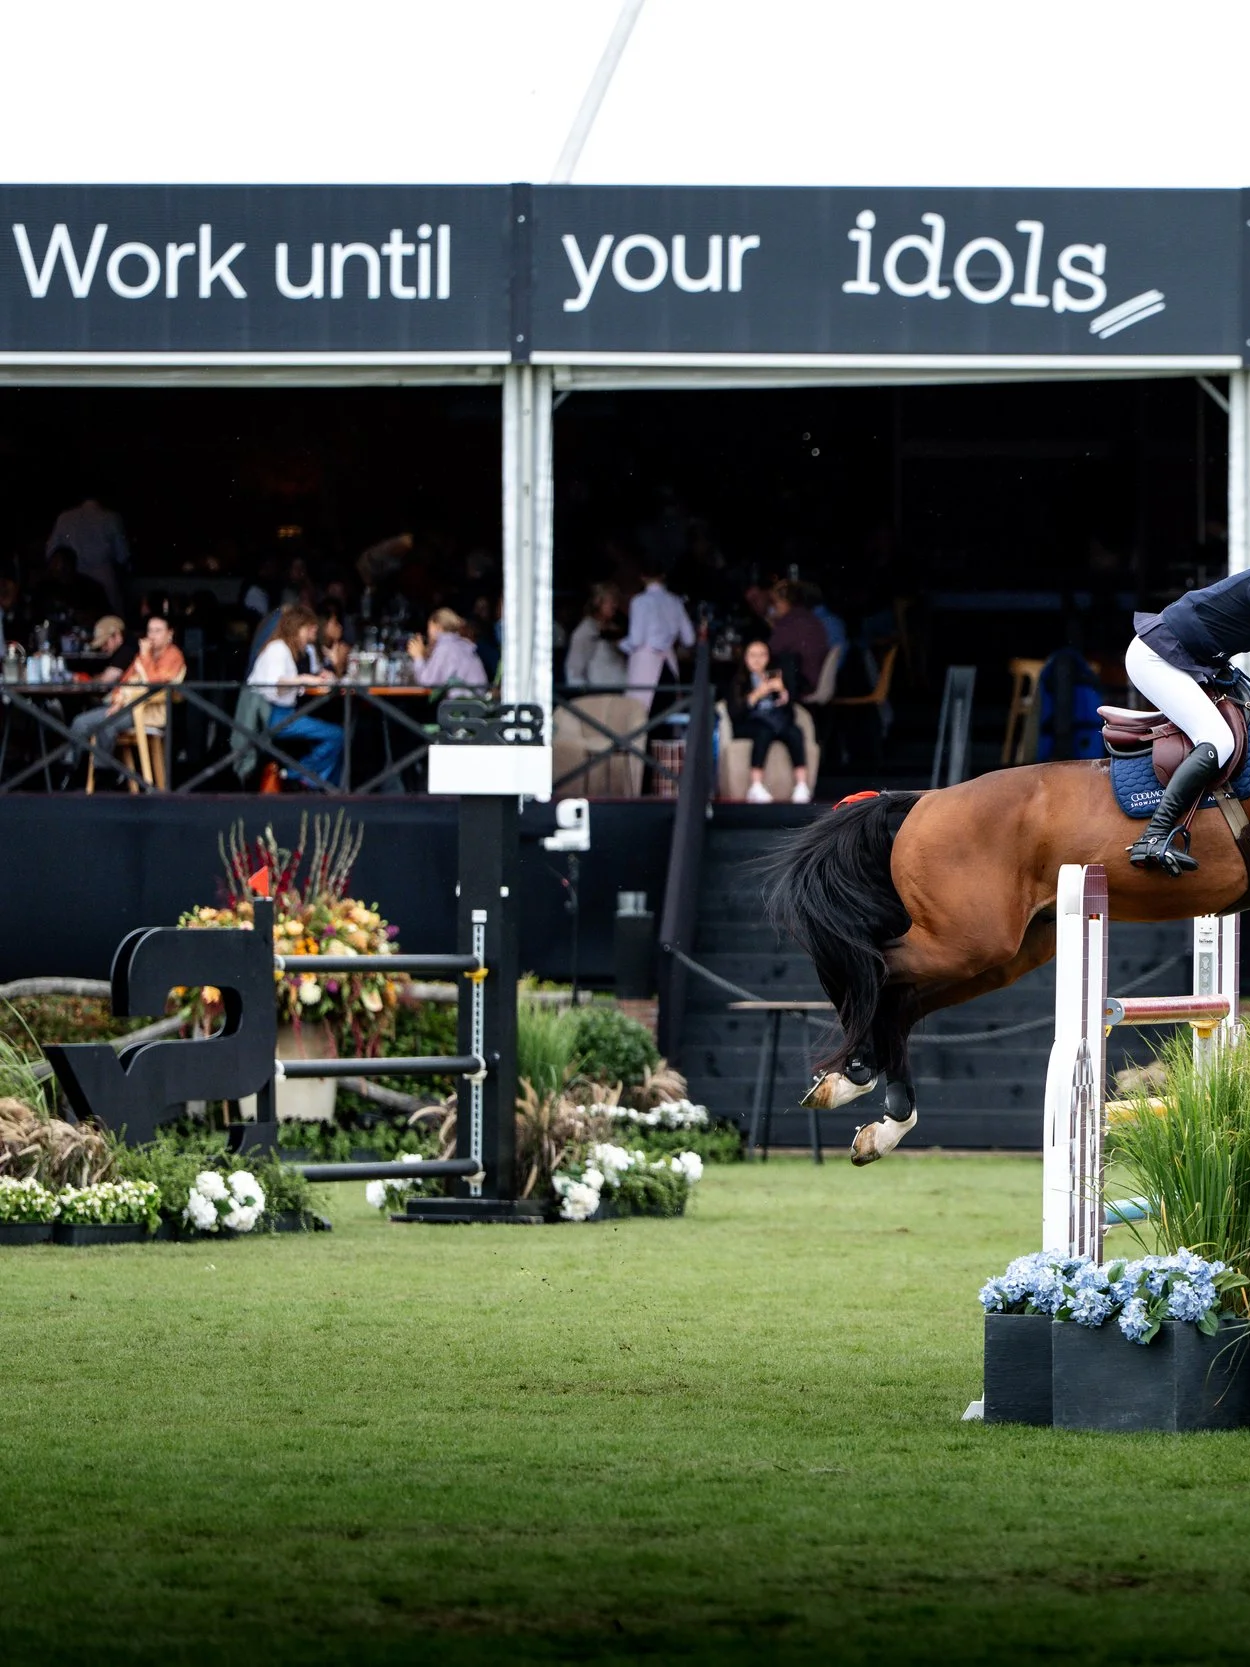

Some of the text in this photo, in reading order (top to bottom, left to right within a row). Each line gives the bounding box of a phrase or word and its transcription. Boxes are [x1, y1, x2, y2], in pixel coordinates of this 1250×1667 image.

[13, 224, 247, 299] Work
[276, 224, 451, 300] until
[562, 235, 761, 312] your
[843, 210, 1107, 314] idols
[1131, 789, 1166, 802] COOLMO
[1131, 798, 1160, 807] SHOWJUM
